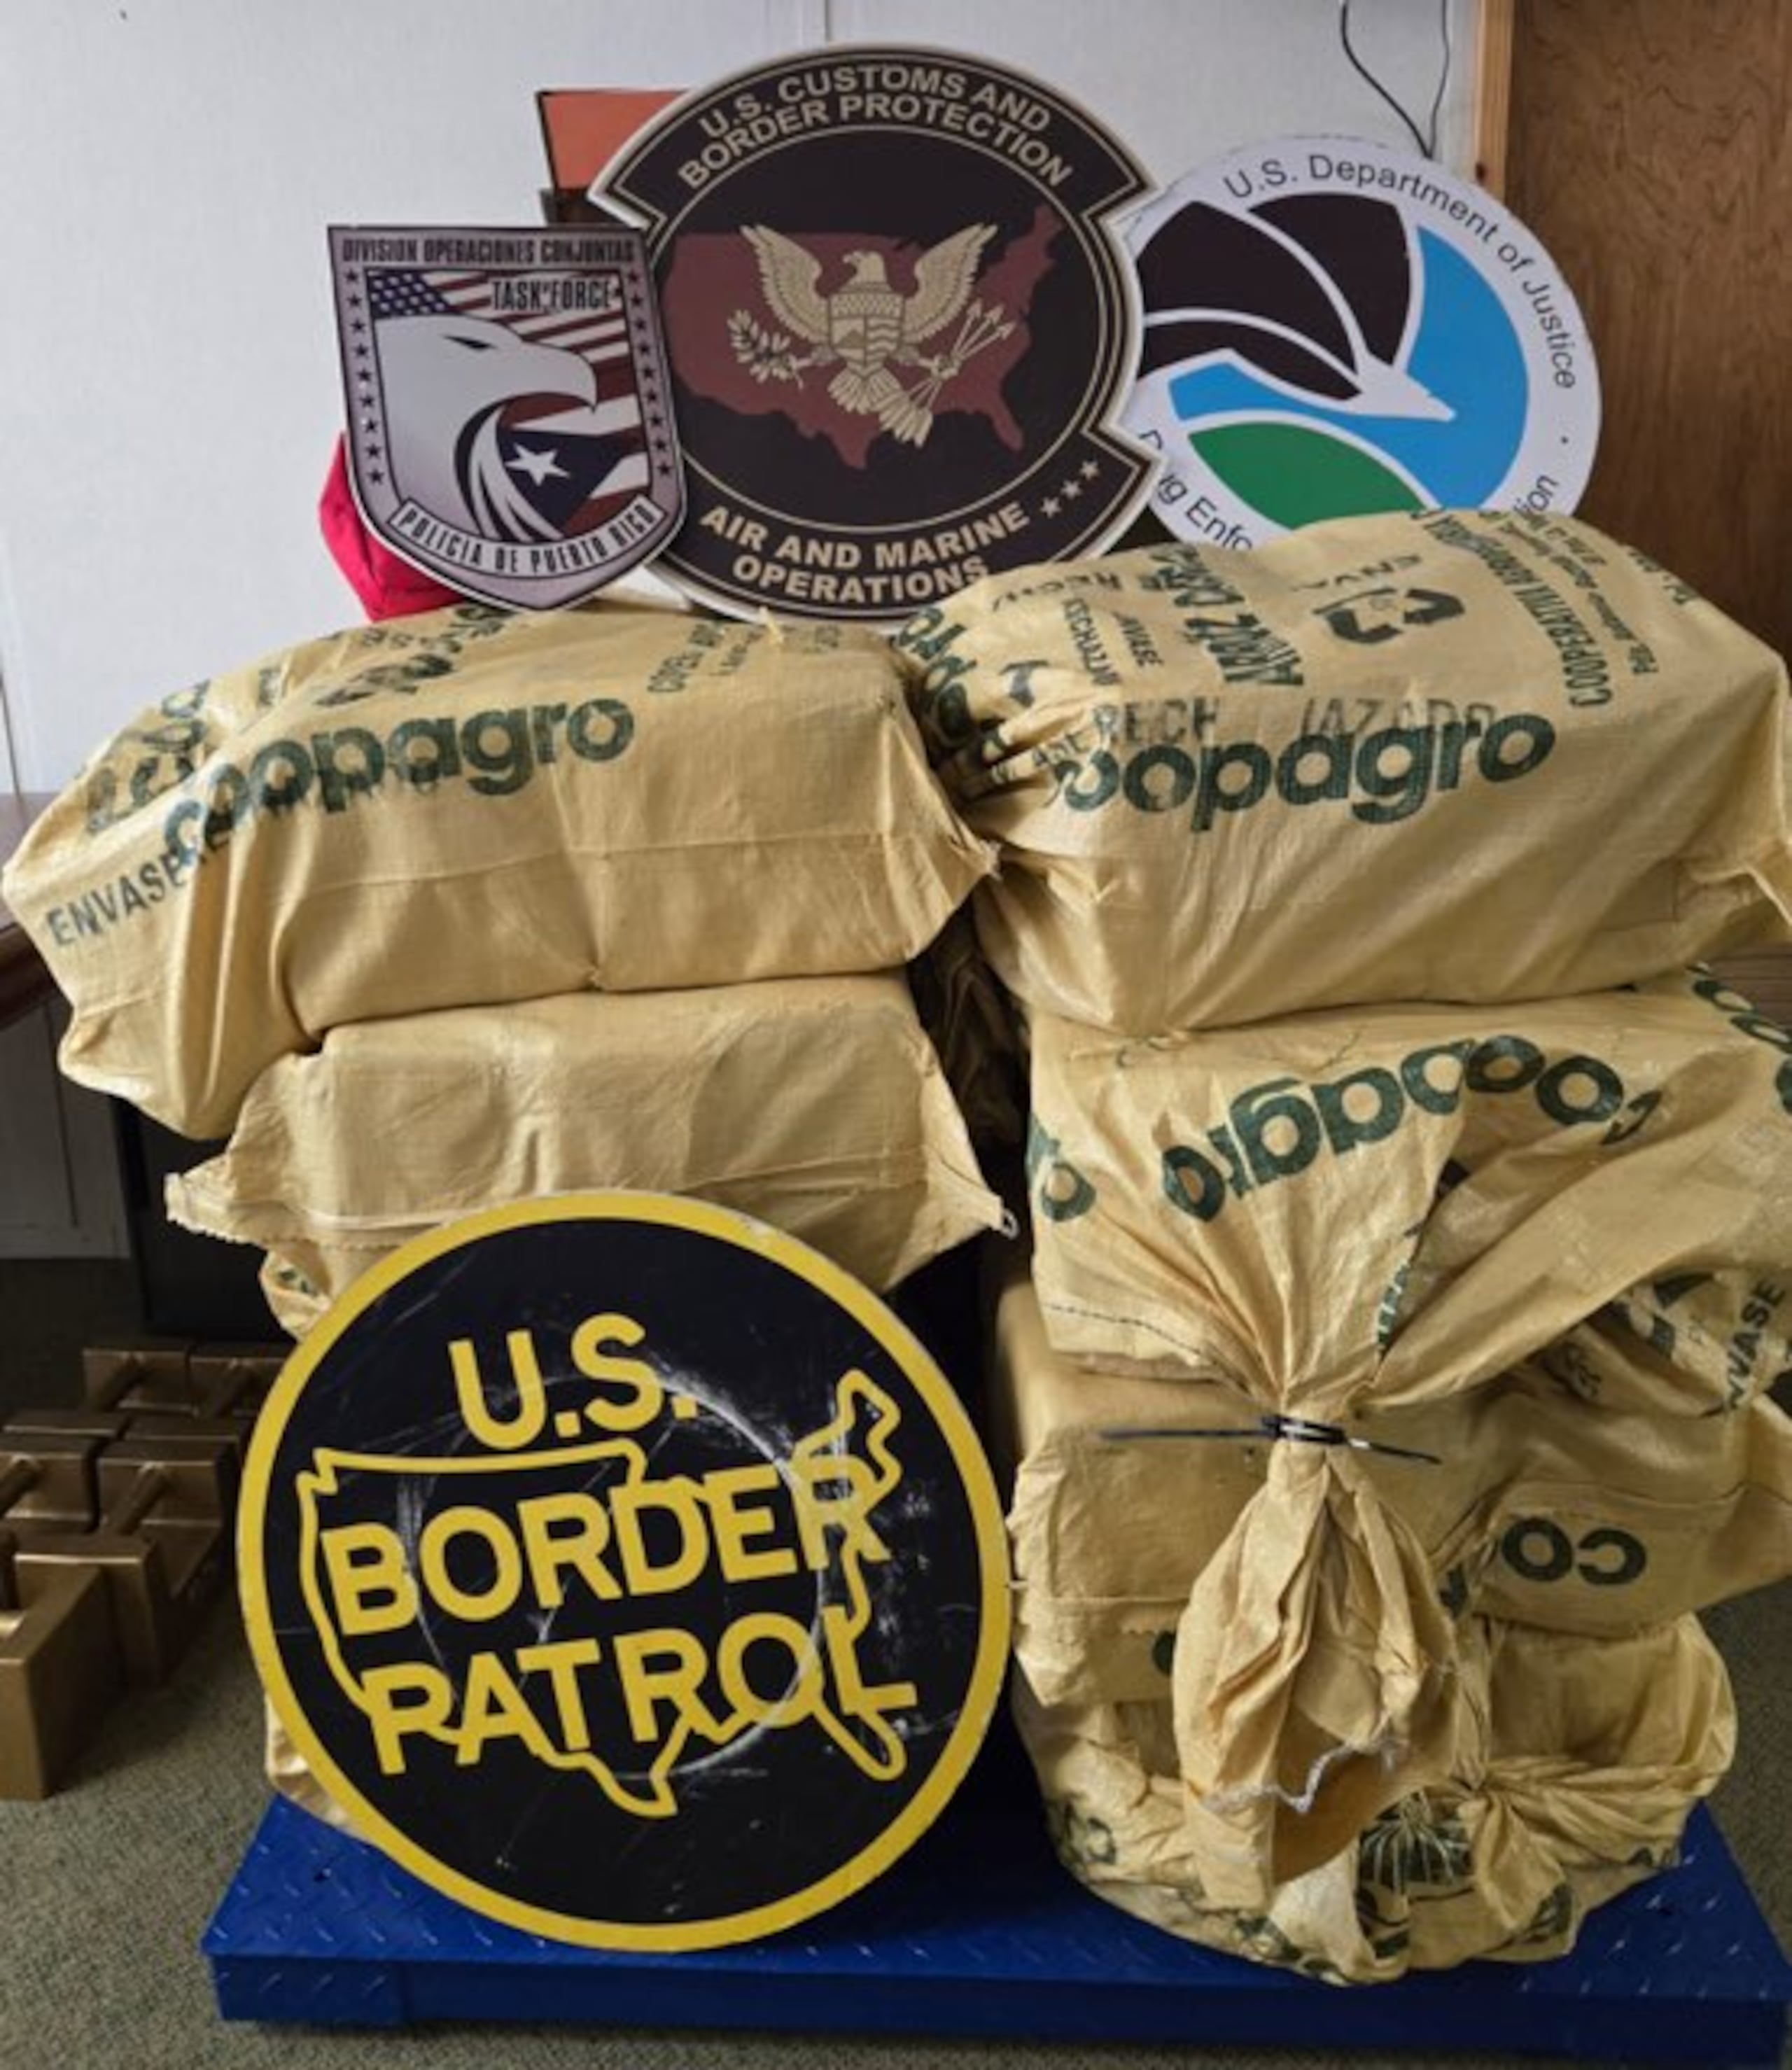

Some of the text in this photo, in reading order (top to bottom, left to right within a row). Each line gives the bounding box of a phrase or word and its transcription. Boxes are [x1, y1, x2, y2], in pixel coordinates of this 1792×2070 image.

[702, 65, 1051, 139] U.S. CUSTOMS AND
[678, 92, 1074, 189] BORDER PROTECTION
[342, 239, 634, 263] DIVISION OPERACIONES CONJUNTAS
[1223, 154, 1576, 389] U.S. Department of Justice
[493, 281, 612, 311] TASK FORCE
[399, 503, 657, 573] POLICIA DE PUERTO RICO
[701, 501, 1030, 569] AIR AND MARINE
[732, 555, 988, 603] OPERATIONS
[448, 1311, 701, 1450] U.S.
[321, 1455, 893, 1637] BORDER
[360, 1603, 918, 1775] PATROL
